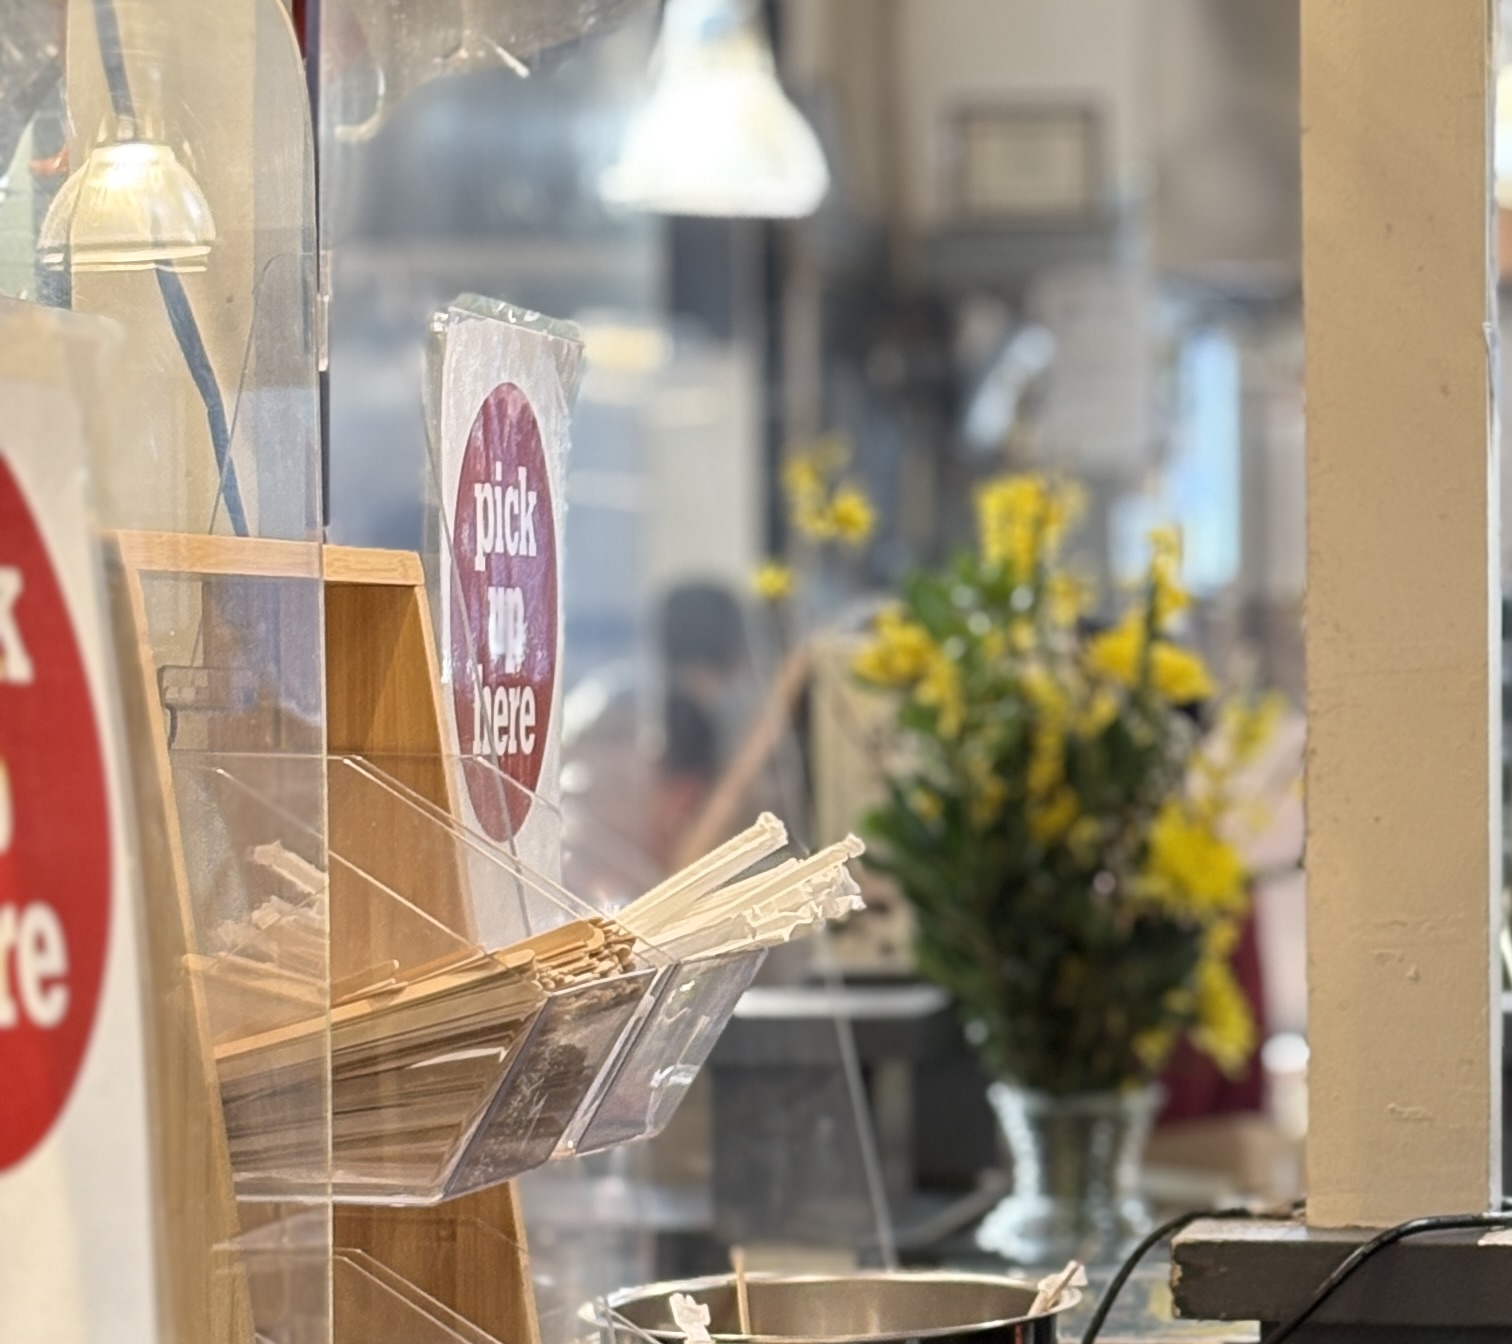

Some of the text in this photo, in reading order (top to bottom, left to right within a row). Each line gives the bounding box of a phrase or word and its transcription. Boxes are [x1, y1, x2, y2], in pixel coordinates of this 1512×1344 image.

[473, 460, 537, 572] pick
[487, 586, 529, 674] up
[472, 663, 536, 756] here
